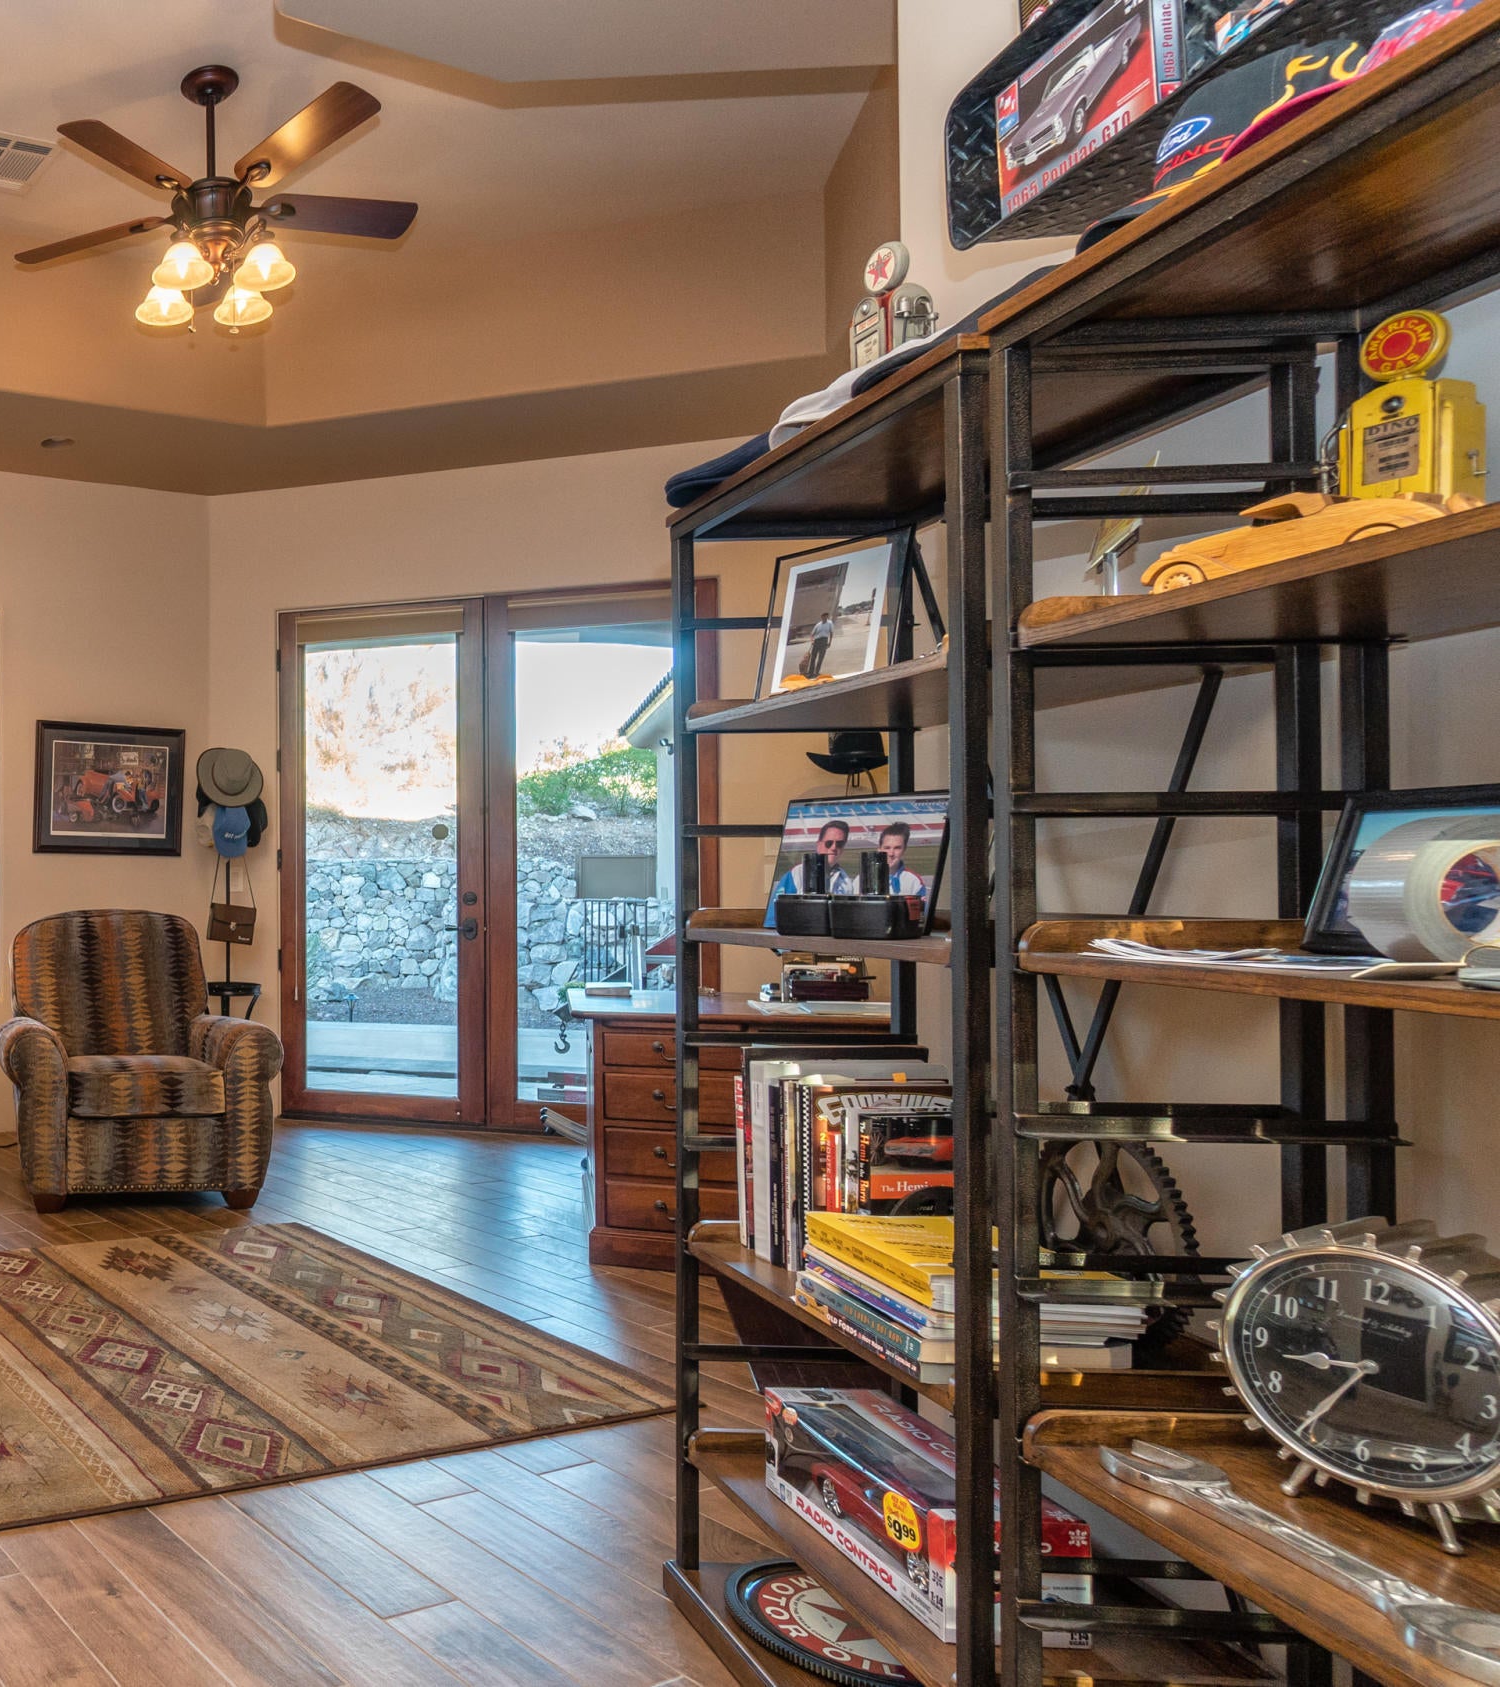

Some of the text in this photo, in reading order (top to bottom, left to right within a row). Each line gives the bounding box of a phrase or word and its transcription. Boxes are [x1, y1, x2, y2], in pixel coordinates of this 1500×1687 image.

[1159, 123, 1194, 157] Ford
[1040, 137, 1097, 188] Pontiac
[1366, 319, 1432, 361] AMERICAN
[1380, 353, 1421, 373] GAS
[1368, 416, 1419, 436] DINO
[859, 1134, 870, 1162] Hemi
[859, 1179, 870, 1203] Barn
[881, 1184, 895, 1193] The
[1315, 1276, 1339, 1302] 11
[1363, 1278, 1390, 1306] 12
[1272, 1294, 1299, 1320] 10
[1427, 1305, 1438, 1329] 1
[826, 1313, 838, 1326] OLD
[838, 1319, 857, 1337] FORDS
[1255, 1327, 1269, 1348] 9
[1464, 1346, 1480, 1372] 2
[1268, 1370, 1283, 1393] 8
[1480, 1394, 1498, 1419] 3
[871, 1403, 931, 1441] RADIO
[1355, 1439, 1371, 1462] 6
[1455, 1432, 1472, 1457] 4
[1409, 1448, 1427, 1471] 5
[795, 1496, 898, 1592] RADIO CONTROL
[762, 1575, 820, 1639] MOTOR
[822, 1646, 906, 1679] OIL
